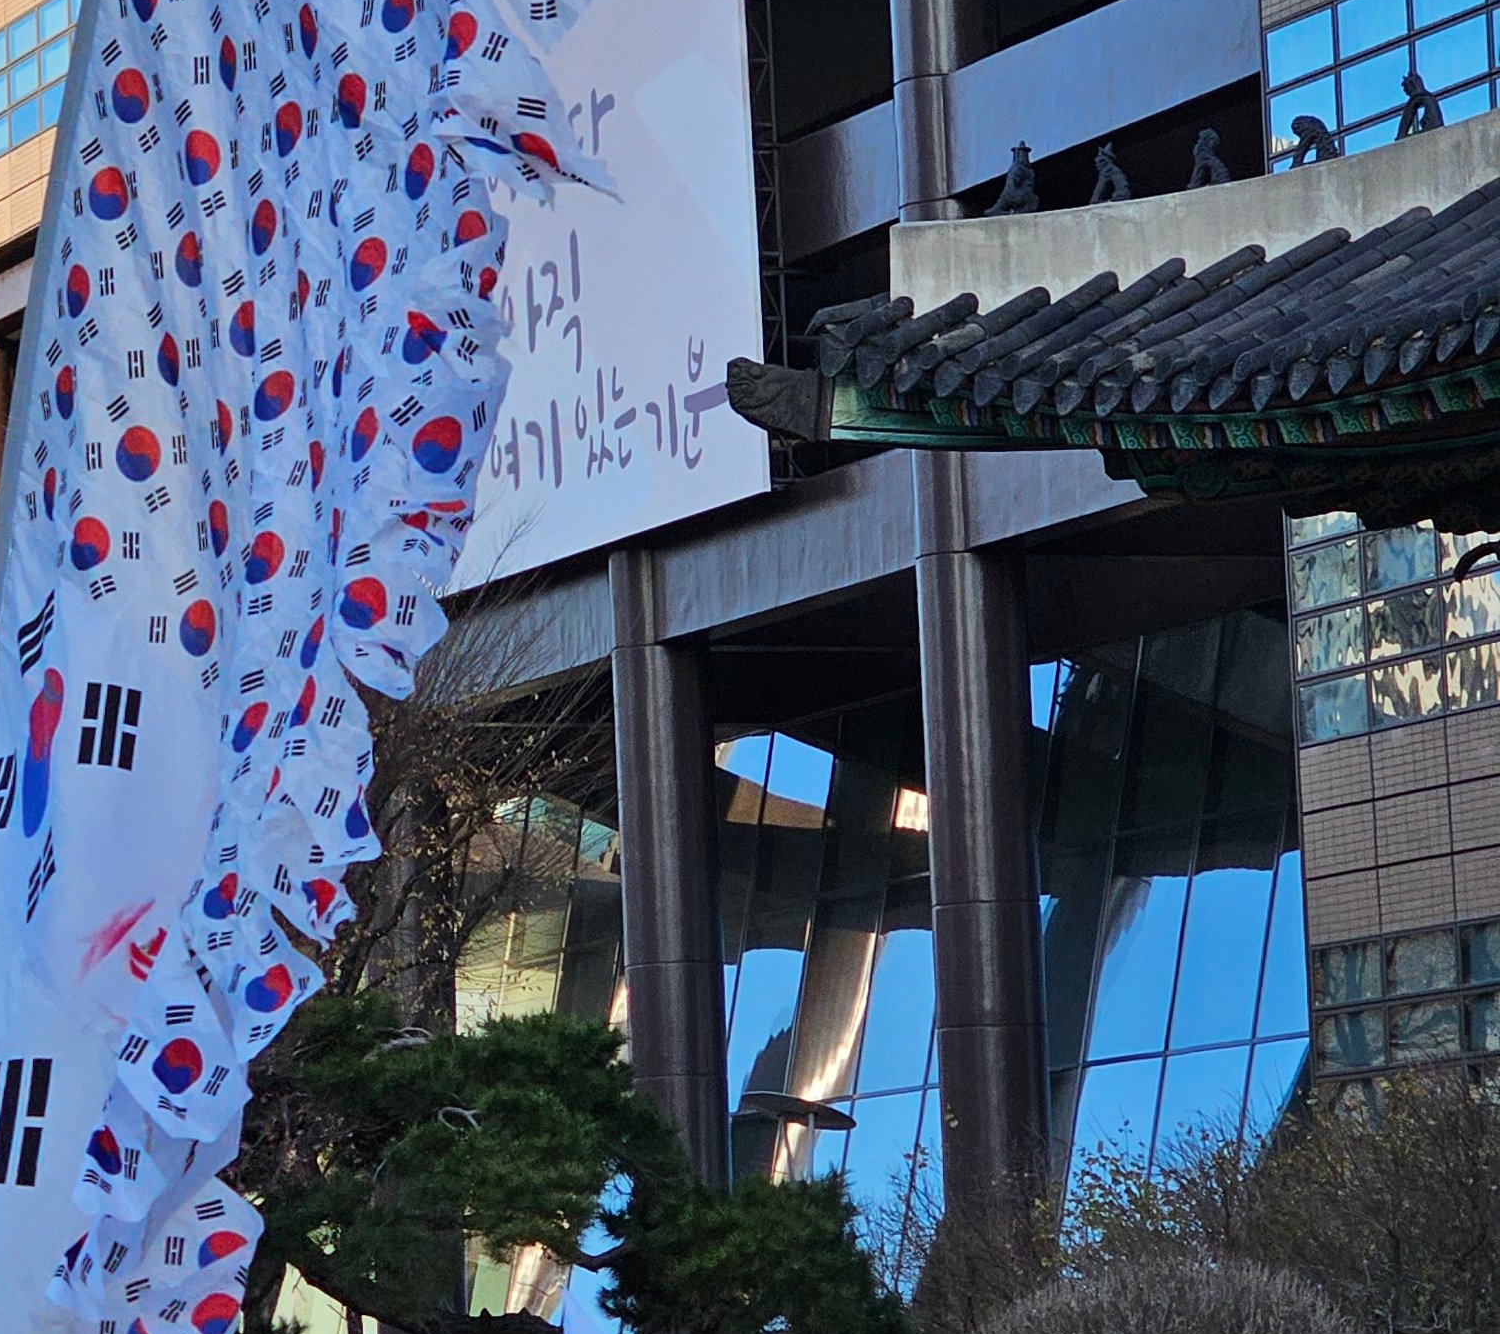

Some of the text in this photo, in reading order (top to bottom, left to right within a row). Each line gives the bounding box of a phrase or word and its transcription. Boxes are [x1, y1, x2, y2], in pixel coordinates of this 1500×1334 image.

[501, 228, 581, 374] 아직
[490, 334, 729, 492] 여기 있는 기분
